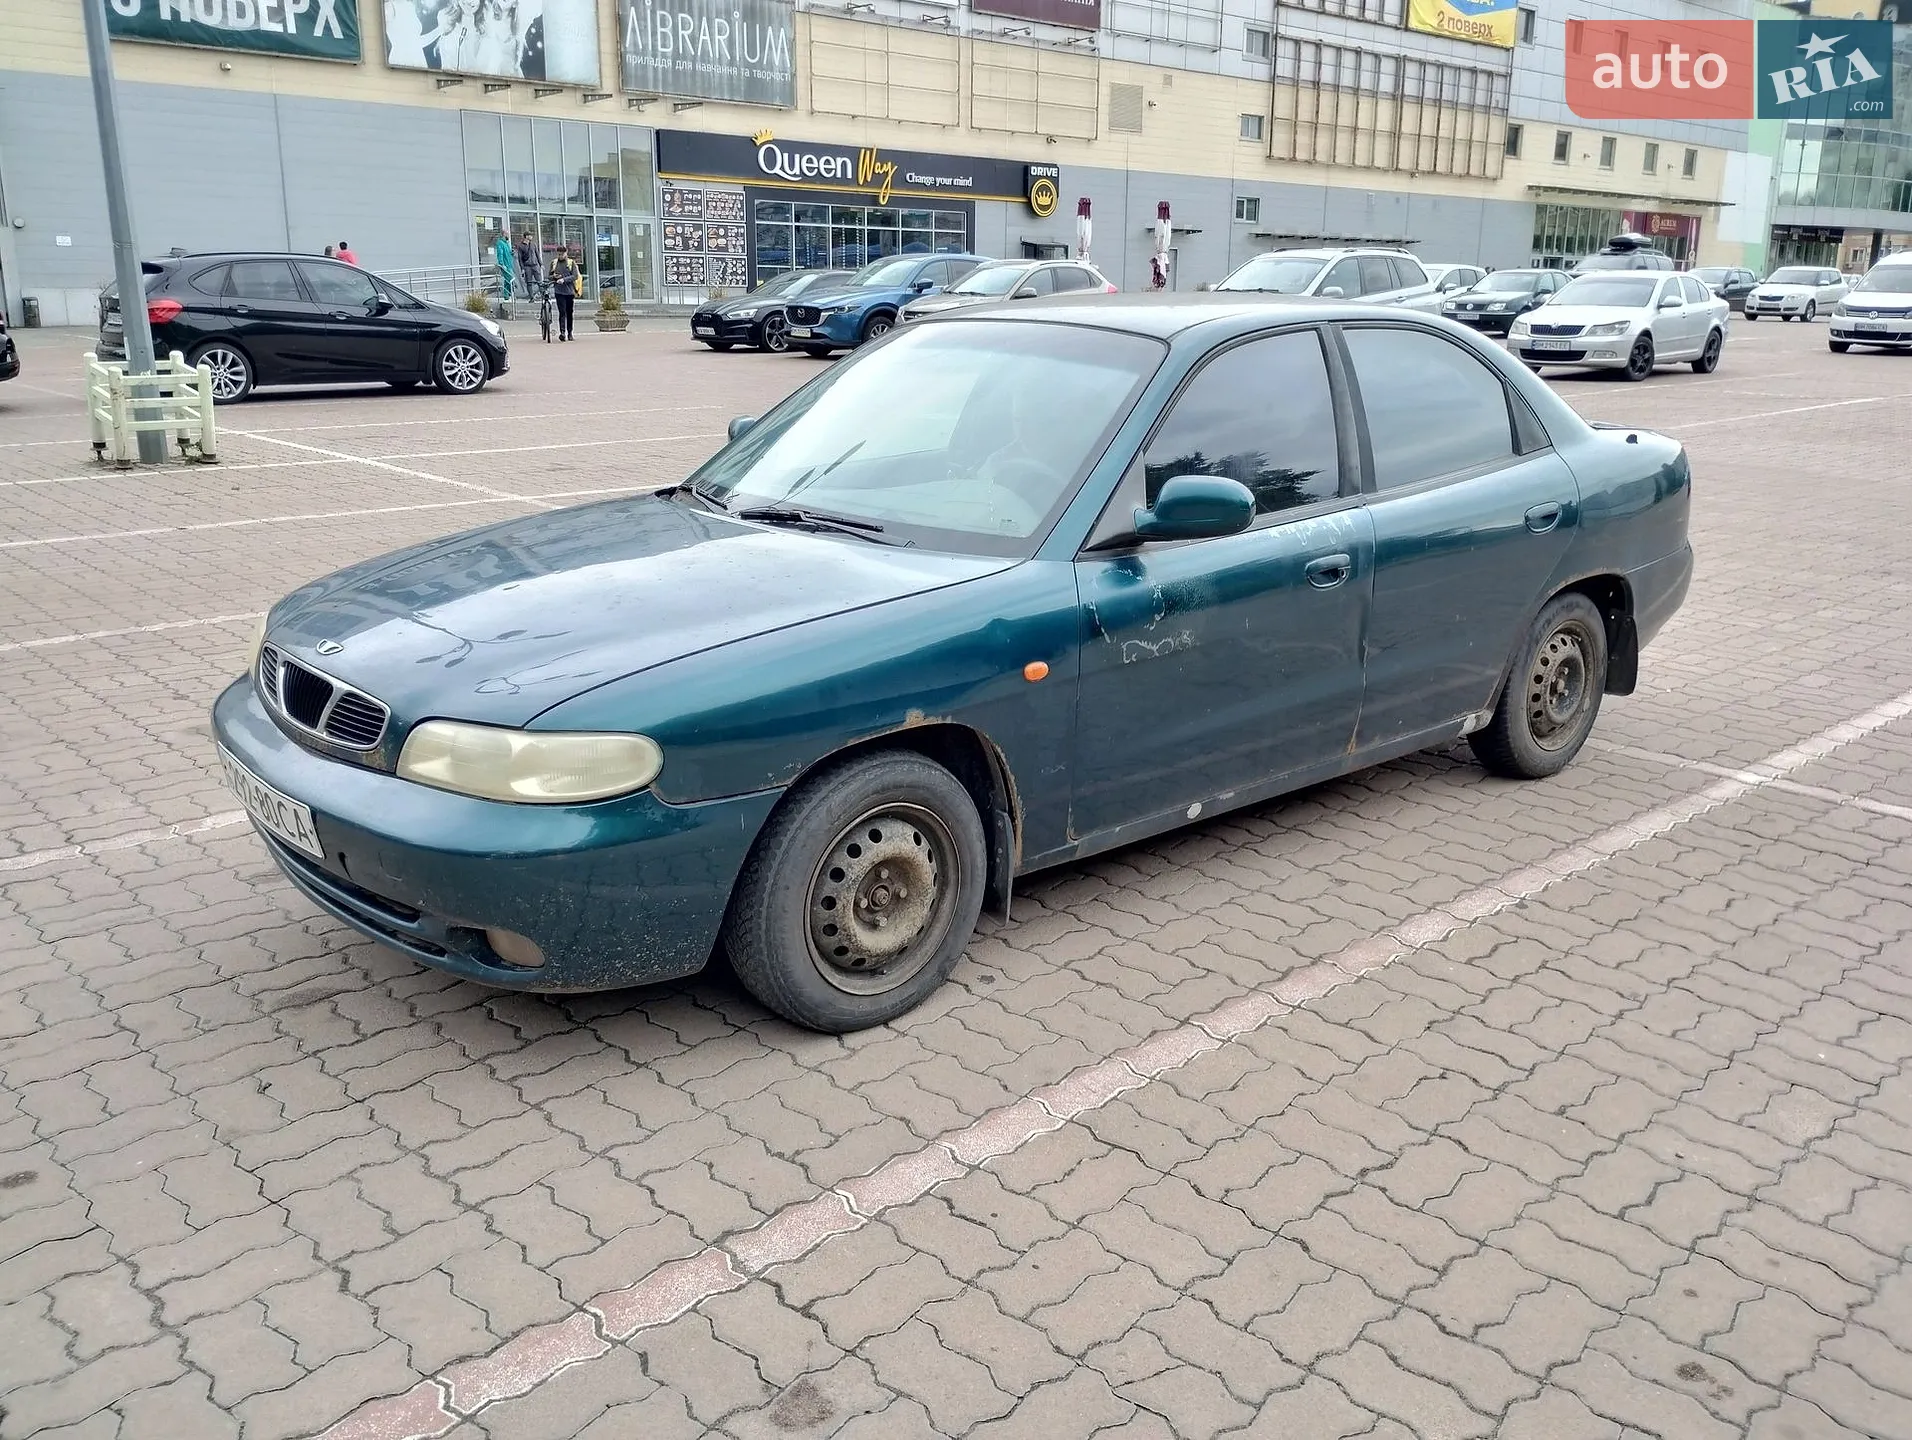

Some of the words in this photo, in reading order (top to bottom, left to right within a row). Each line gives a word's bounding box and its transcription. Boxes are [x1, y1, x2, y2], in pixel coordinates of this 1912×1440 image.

[1437, 10, 1445, 28] 2
[1447, 17, 1494, 38] поверх
[626, 54, 672, 69] приладдя
[675, 60, 693, 71] для
[696, 62, 738, 77] навчання
[741, 67, 750, 78] та
[753, 68, 791, 82] творчості
[757, 143, 853, 182] Queen
[857, 144, 899, 205] Way
[906, 172, 935, 186] Change
[936, 176, 953, 188] your
[953, 175, 973, 187] mind
[1030, 165, 1059, 178] DRIVE
